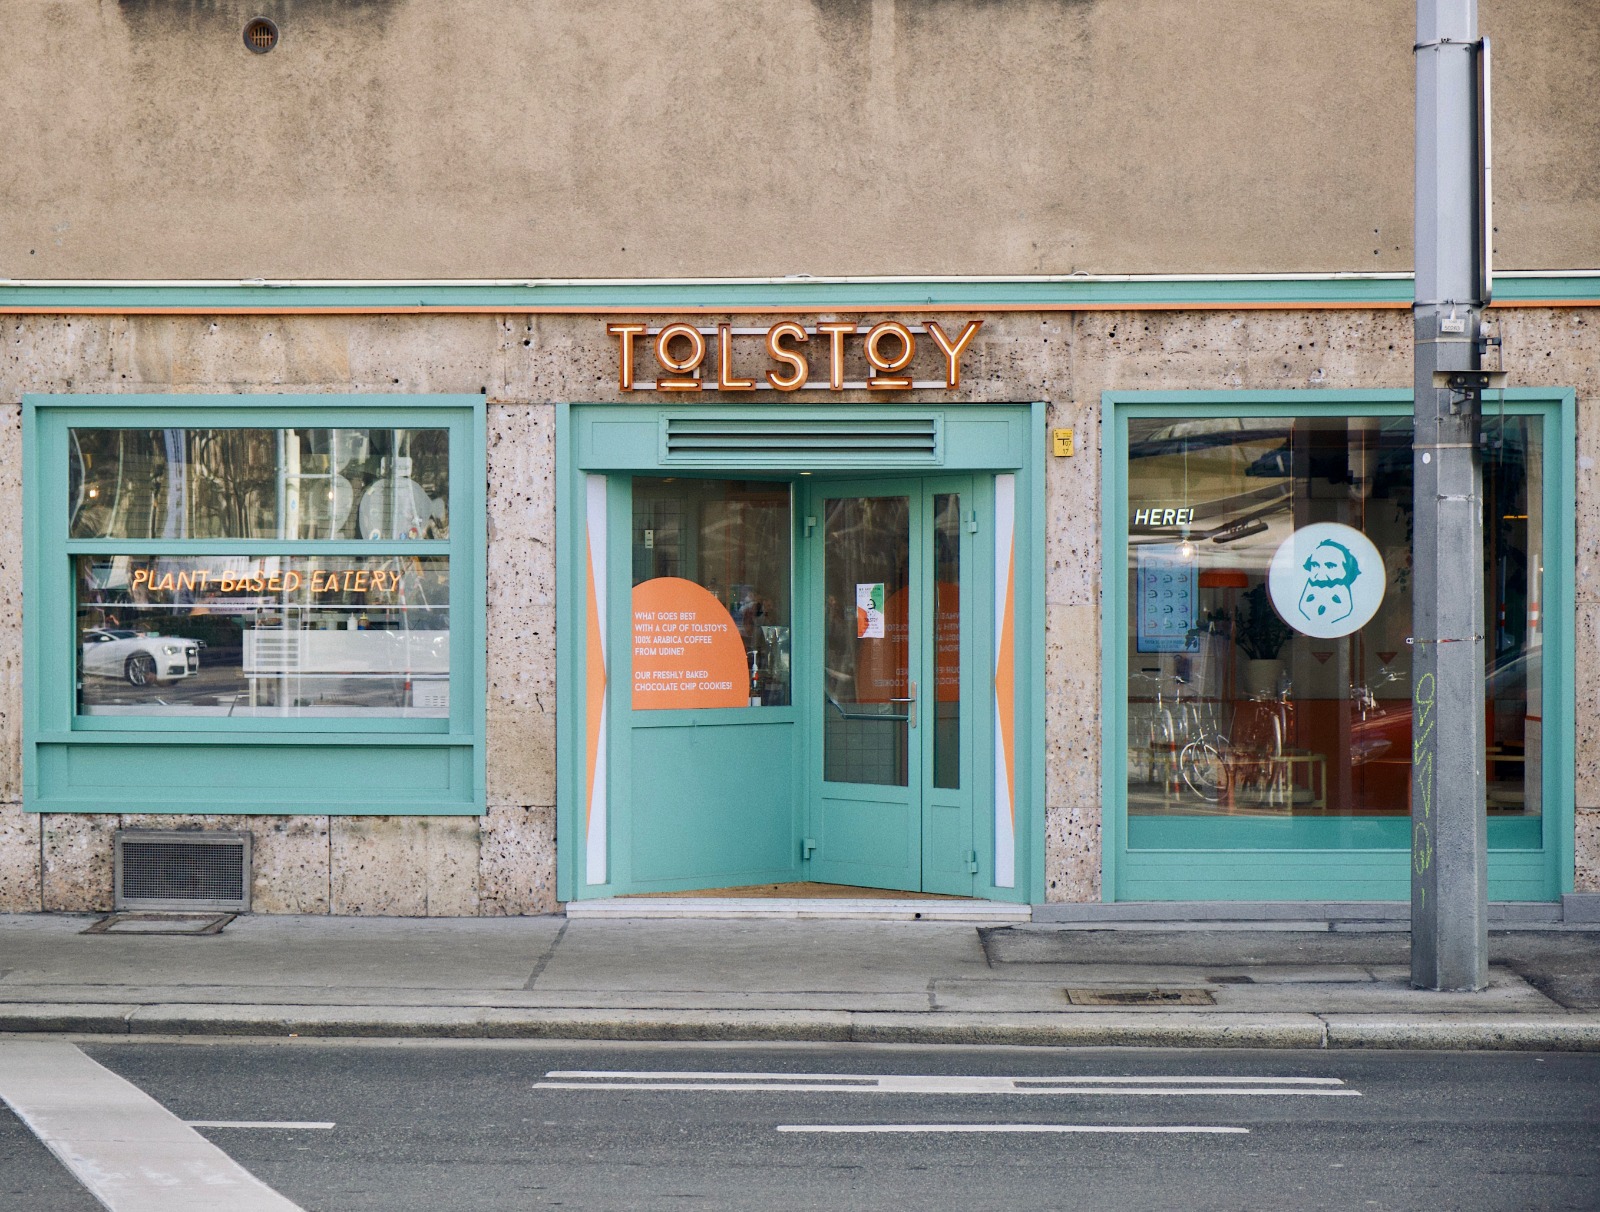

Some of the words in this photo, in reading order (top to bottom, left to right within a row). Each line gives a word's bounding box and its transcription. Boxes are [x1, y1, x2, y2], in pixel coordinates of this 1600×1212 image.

[606, 320, 984, 392] TOLSTOY
[1134, 508, 1194, 526] HERE!
[132, 569, 300, 593] PLANT-BASED
[310, 569, 402, 593] EATERY
[635, 612, 655, 621] WHAT
[657, 612, 678, 621] GOES
[679, 612, 696, 621] BEST
[635, 624, 654, 632] WITH
[655, 624, 660, 632] A
[661, 624, 677, 632] CUP
[678, 624, 689, 632] OF
[691, 624, 728, 632] TOLSTOY'S
[635, 635, 651, 644] 100%
[653, 635, 682, 644] ARABICA
[683, 635, 712, 644] COFFEE
[635, 647, 657, 656] FROM
[659, 647, 685, 656] UDINE?
[635, 671, 651, 679] OUR
[652, 671, 684, 679] FRESHLY
[685, 670, 709, 679] BAKED
[635, 682, 678, 691] CHOCOLATE
[679, 682, 696, 691] CHIP
[698, 682, 733, 690] COOKIES!
